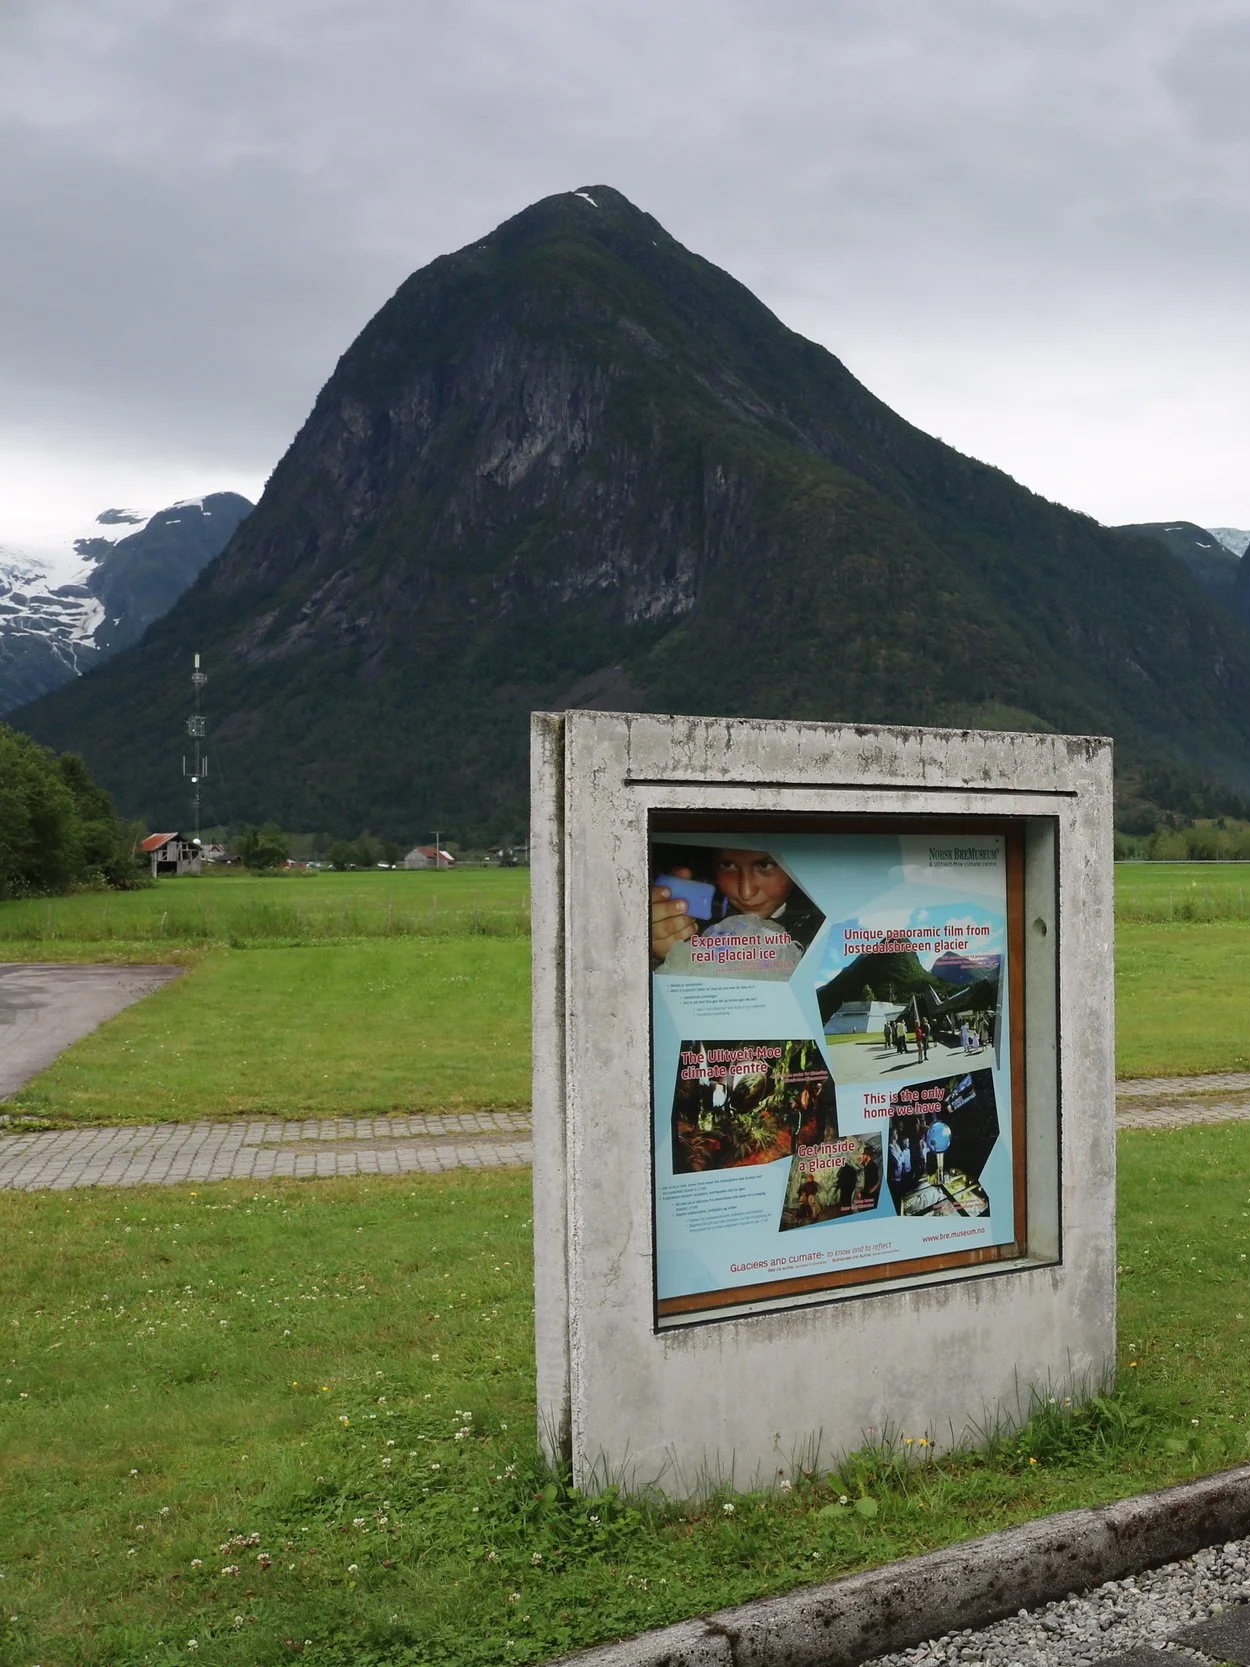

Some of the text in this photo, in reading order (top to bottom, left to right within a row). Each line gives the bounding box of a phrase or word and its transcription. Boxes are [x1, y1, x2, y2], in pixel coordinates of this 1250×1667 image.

[690, 932, 792, 948] Experiment with
[844, 925, 990, 942] Unique panoramic film from
[934, 939, 969, 953] glacier
[691, 948, 776, 964] real glacial ice
[681, 1046, 782, 1065] The Ulltveit-Moe
[682, 1062, 768, 1080] climate centre
[864, 1086, 946, 1105] This is the only
[864, 1102, 942, 1119] home we have
[798, 1140, 856, 1158] Get inside
[799, 1156, 846, 1173] a glacier
[922, 1228, 985, 1242] www.bre.museum.no
[834, 1248, 851, 1257] know
[852, 1244, 864, 1253] and
[872, 1241, 892, 1251] reflect
